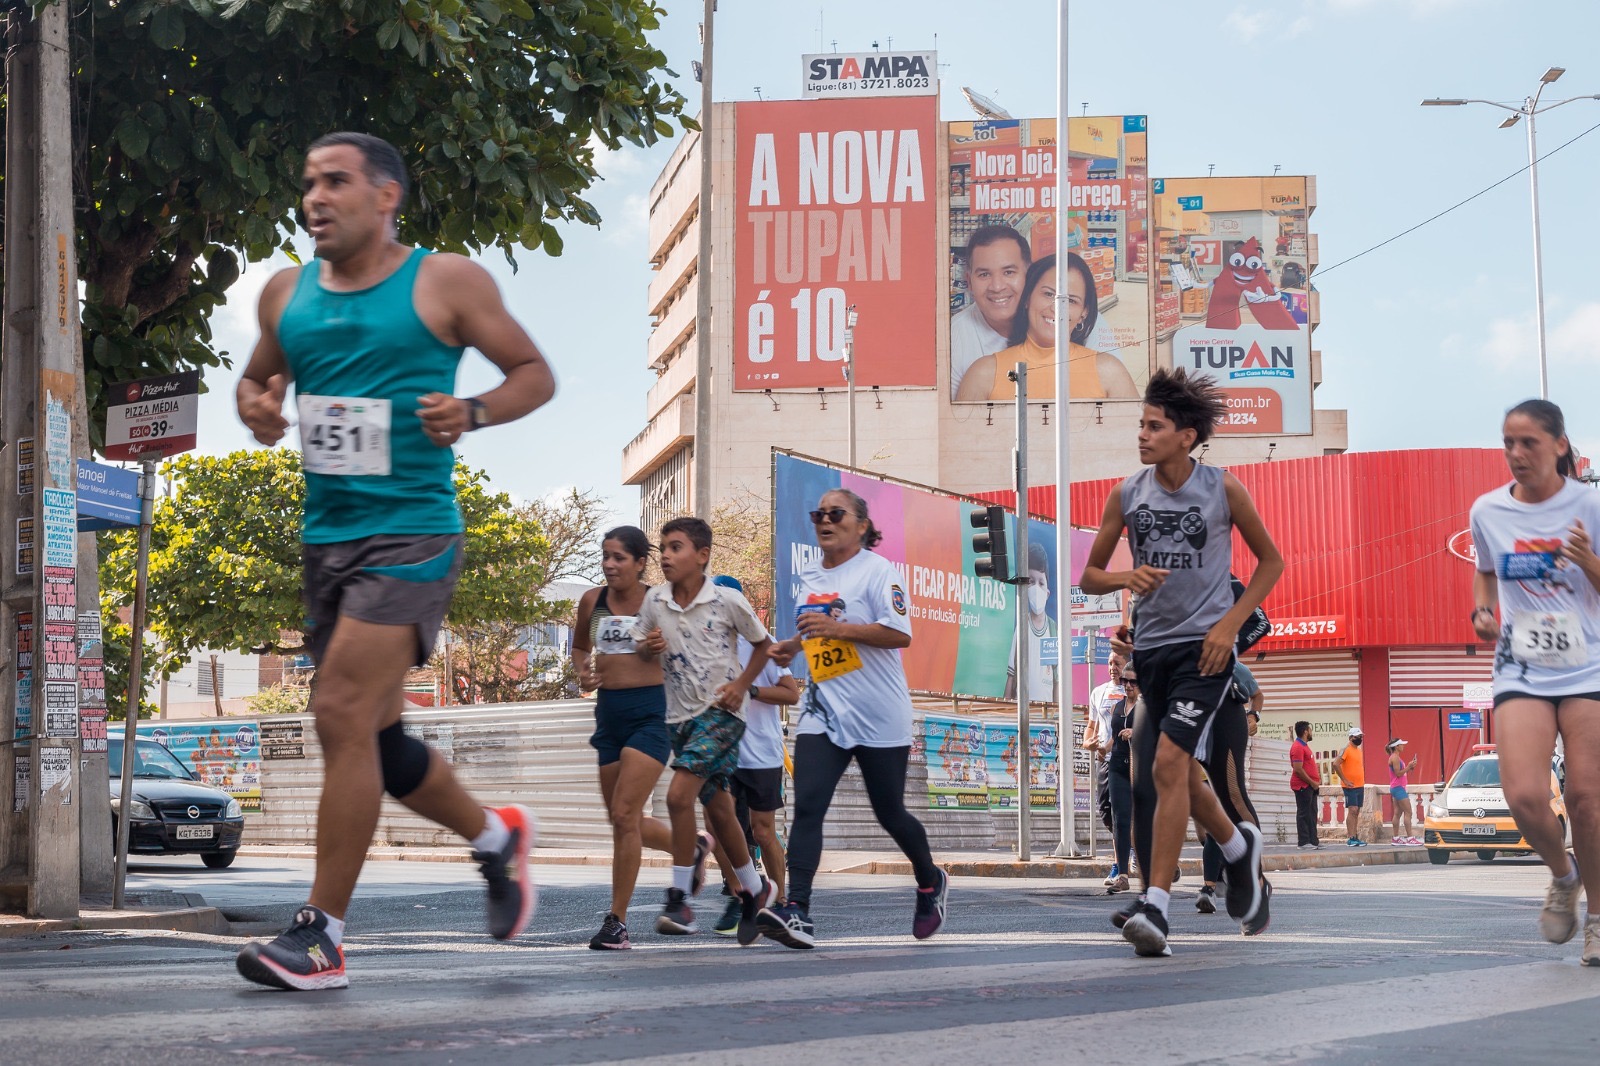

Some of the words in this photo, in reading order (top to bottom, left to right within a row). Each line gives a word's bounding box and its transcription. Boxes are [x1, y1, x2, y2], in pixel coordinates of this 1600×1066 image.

[860, 78, 929, 90] 3721.8023
[749, 133, 780, 206] A
[799, 129, 925, 205] NOVA
[975, 151, 1016, 177] Nova
[1022, 148, 1057, 178] loja.
[975, 184, 1035, 210] Mesmo
[748, 208, 901, 284] TUPAN
[748, 290, 774, 363] é
[790, 287, 846, 362] 10
[1190, 340, 1294, 368] TUPAN
[142, 384, 164, 397] Pizza
[164, 382, 180, 392] Hut
[125, 405, 150, 418] PIZZA
[152, 400, 180, 414] MÉDIA
[150, 420, 168, 437] 39
[308, 424, 362, 452] 451
[128, 443, 144, 454] Hut
[116, 490, 132, 500] Freitas
[48, 533, 72, 542] AMOROSA
[48, 542, 72, 550] ATRATIVA
[913, 565, 944, 600] FICAR
[948, 572, 976, 606] PARA
[928, 605, 956, 624] inclusão
[958, 610, 980, 628] digital
[602, 630, 632, 642] 484
[1043, 640, 1054, 648] Frei
[1526, 630, 1570, 651] 338
[813, 648, 846, 670] 782
